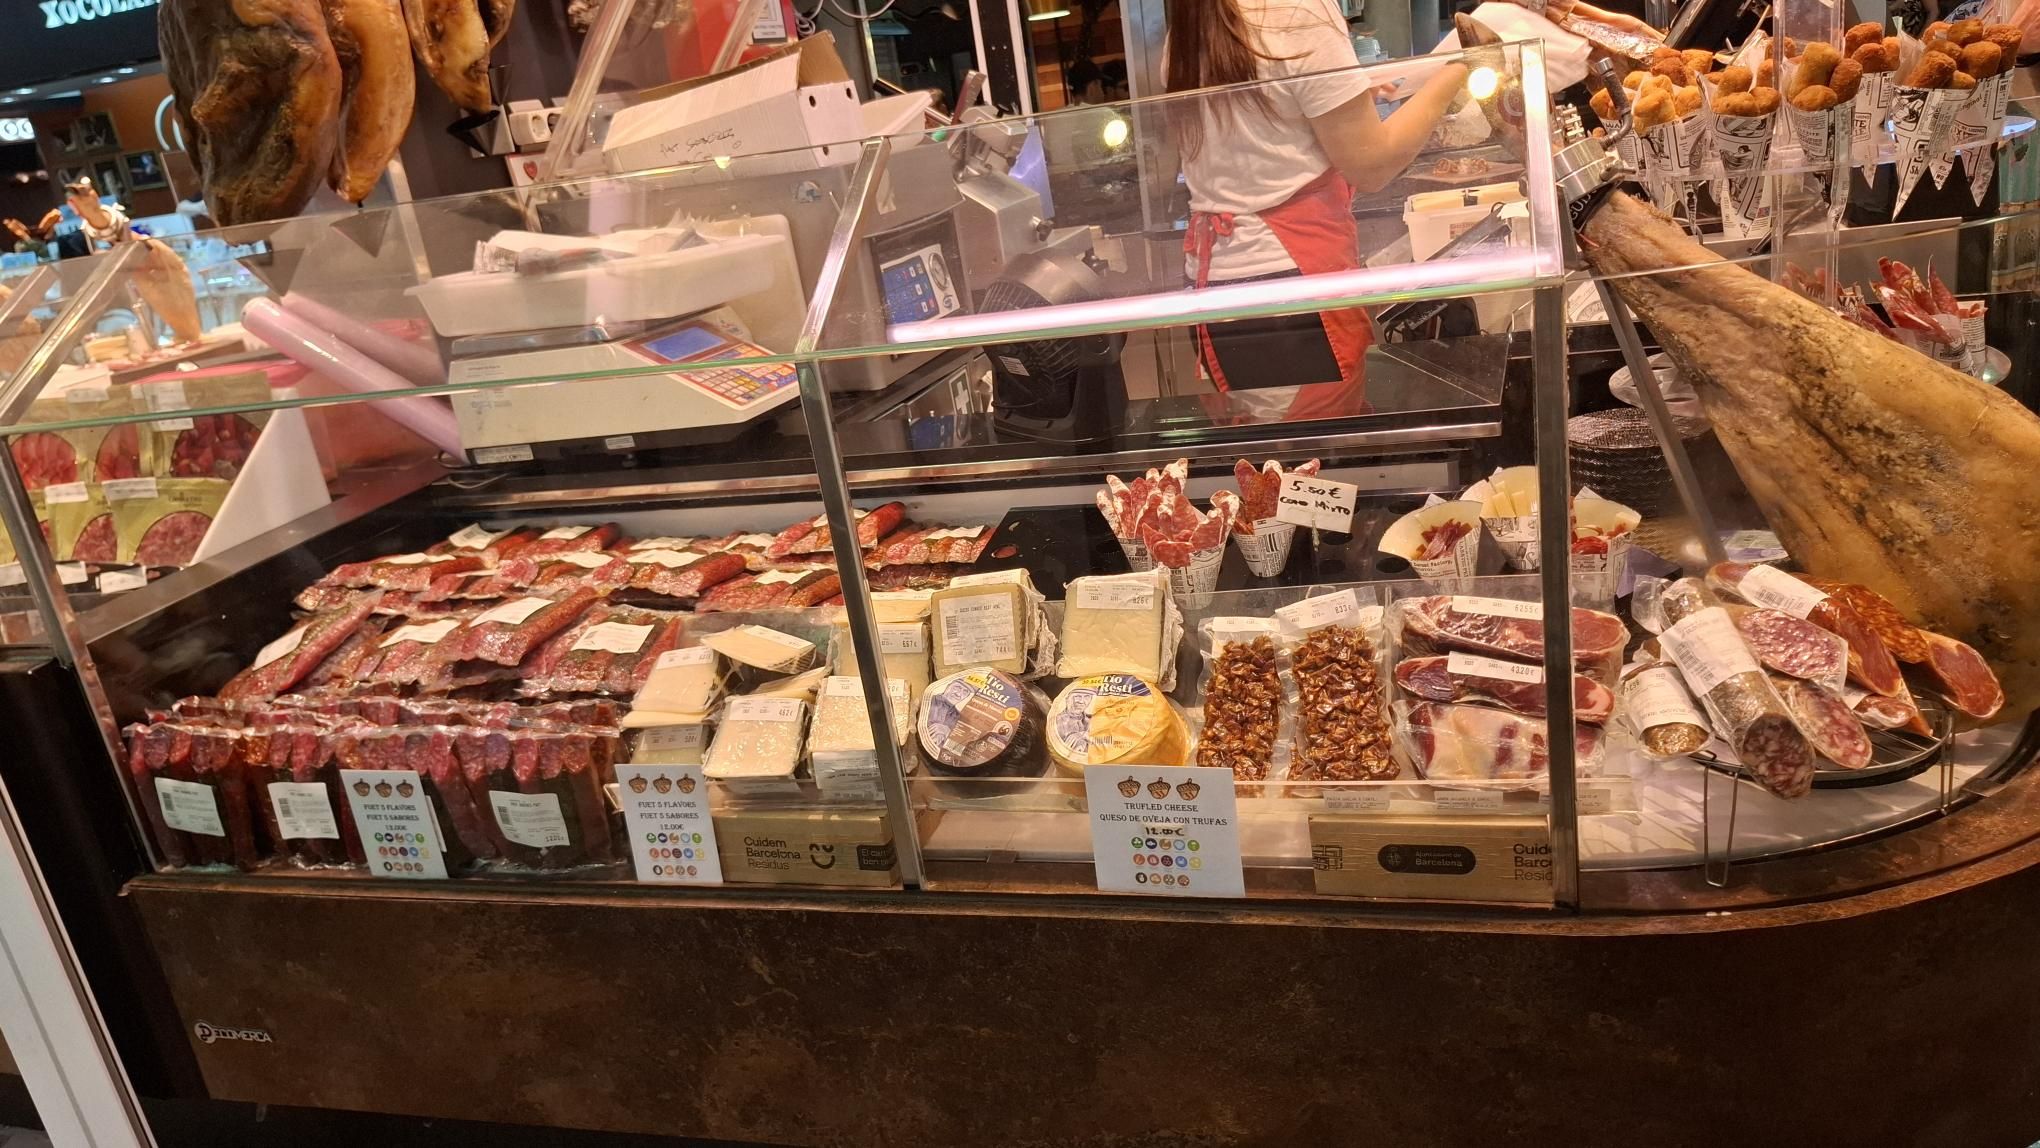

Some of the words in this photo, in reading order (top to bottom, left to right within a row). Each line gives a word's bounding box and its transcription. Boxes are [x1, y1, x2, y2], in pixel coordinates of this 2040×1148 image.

[1124, 802, 1162, 810] TRUFLED
[1164, 803, 1199, 812] CHEESE
[1099, 813, 1127, 821] QUESO
[1142, 815, 1171, 824] OVEJA
[1173, 816, 1190, 824] CON
[1191, 817, 1228, 826] TRUFAS
[744, 836, 787, 848] Cuidem
[746, 847, 801, 859] Barcelona
[748, 858, 790, 870] Residus
[1415, 858, 1463, 867] Barcelona
